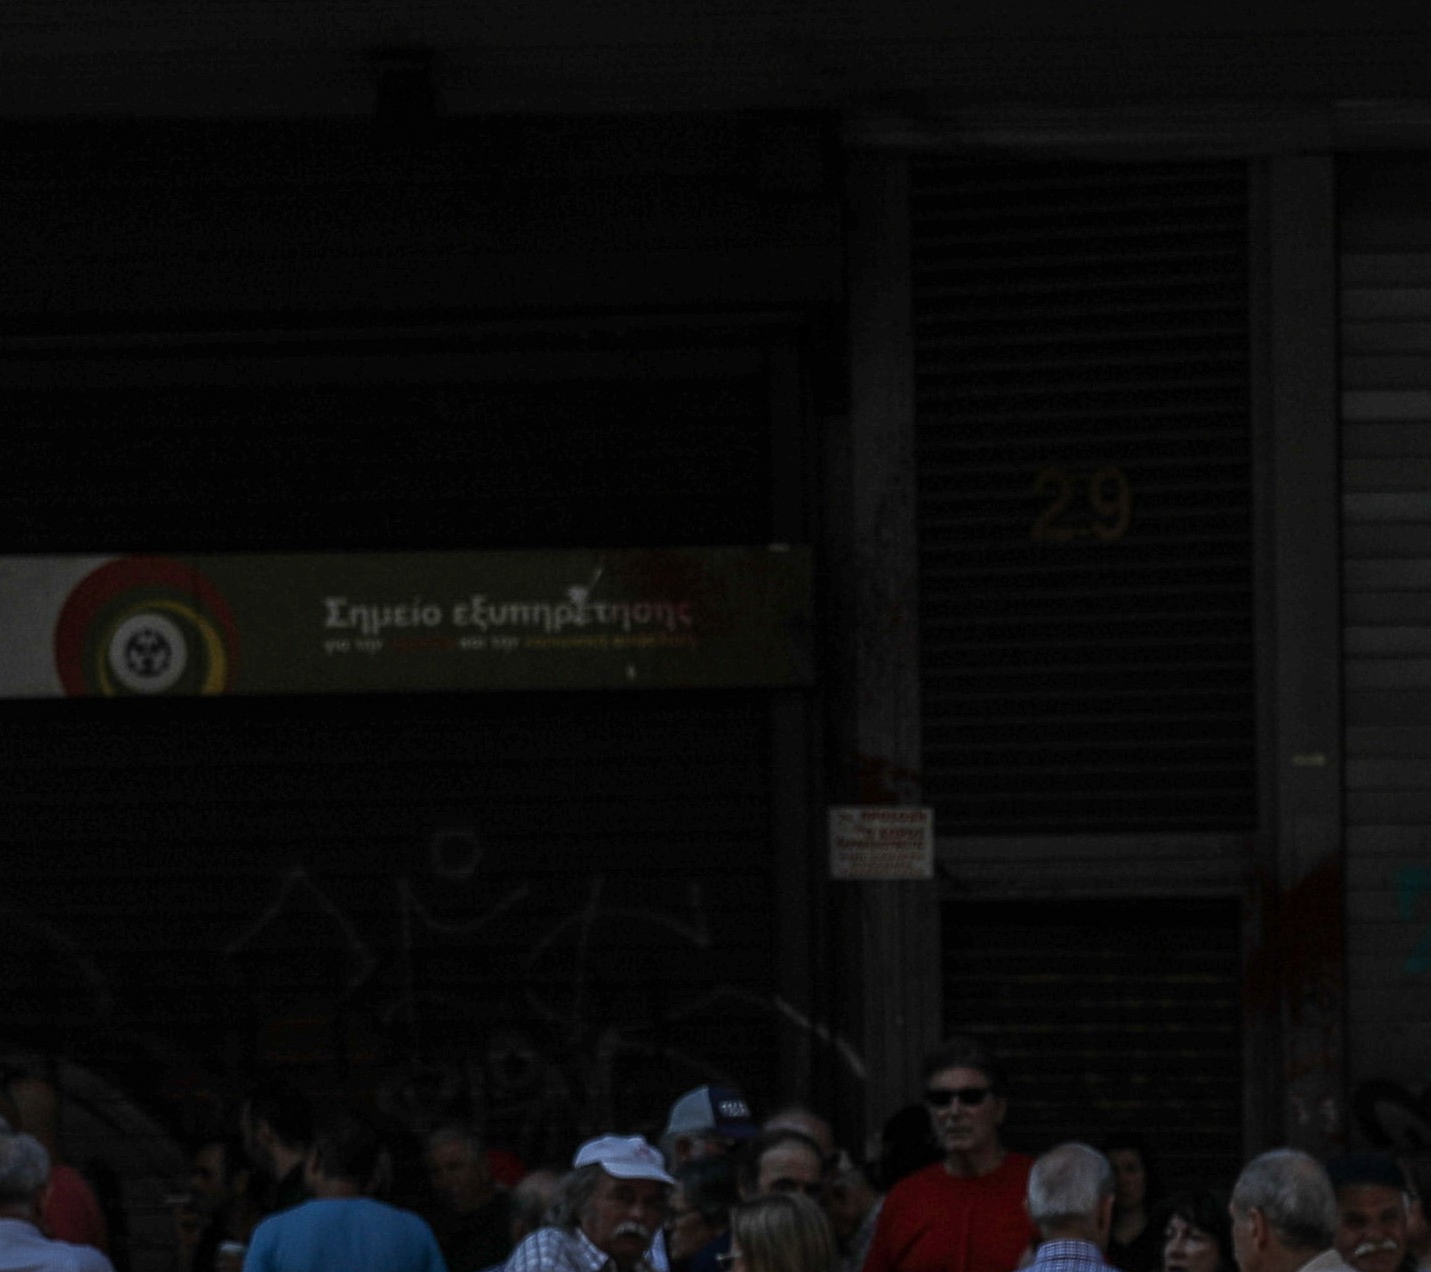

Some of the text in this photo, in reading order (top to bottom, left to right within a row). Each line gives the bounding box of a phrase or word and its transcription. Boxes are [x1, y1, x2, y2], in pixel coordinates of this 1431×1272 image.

[1029, 463, 1133, 541] 29
[323, 593, 695, 636] Σημείο εξυπηρέτησης
